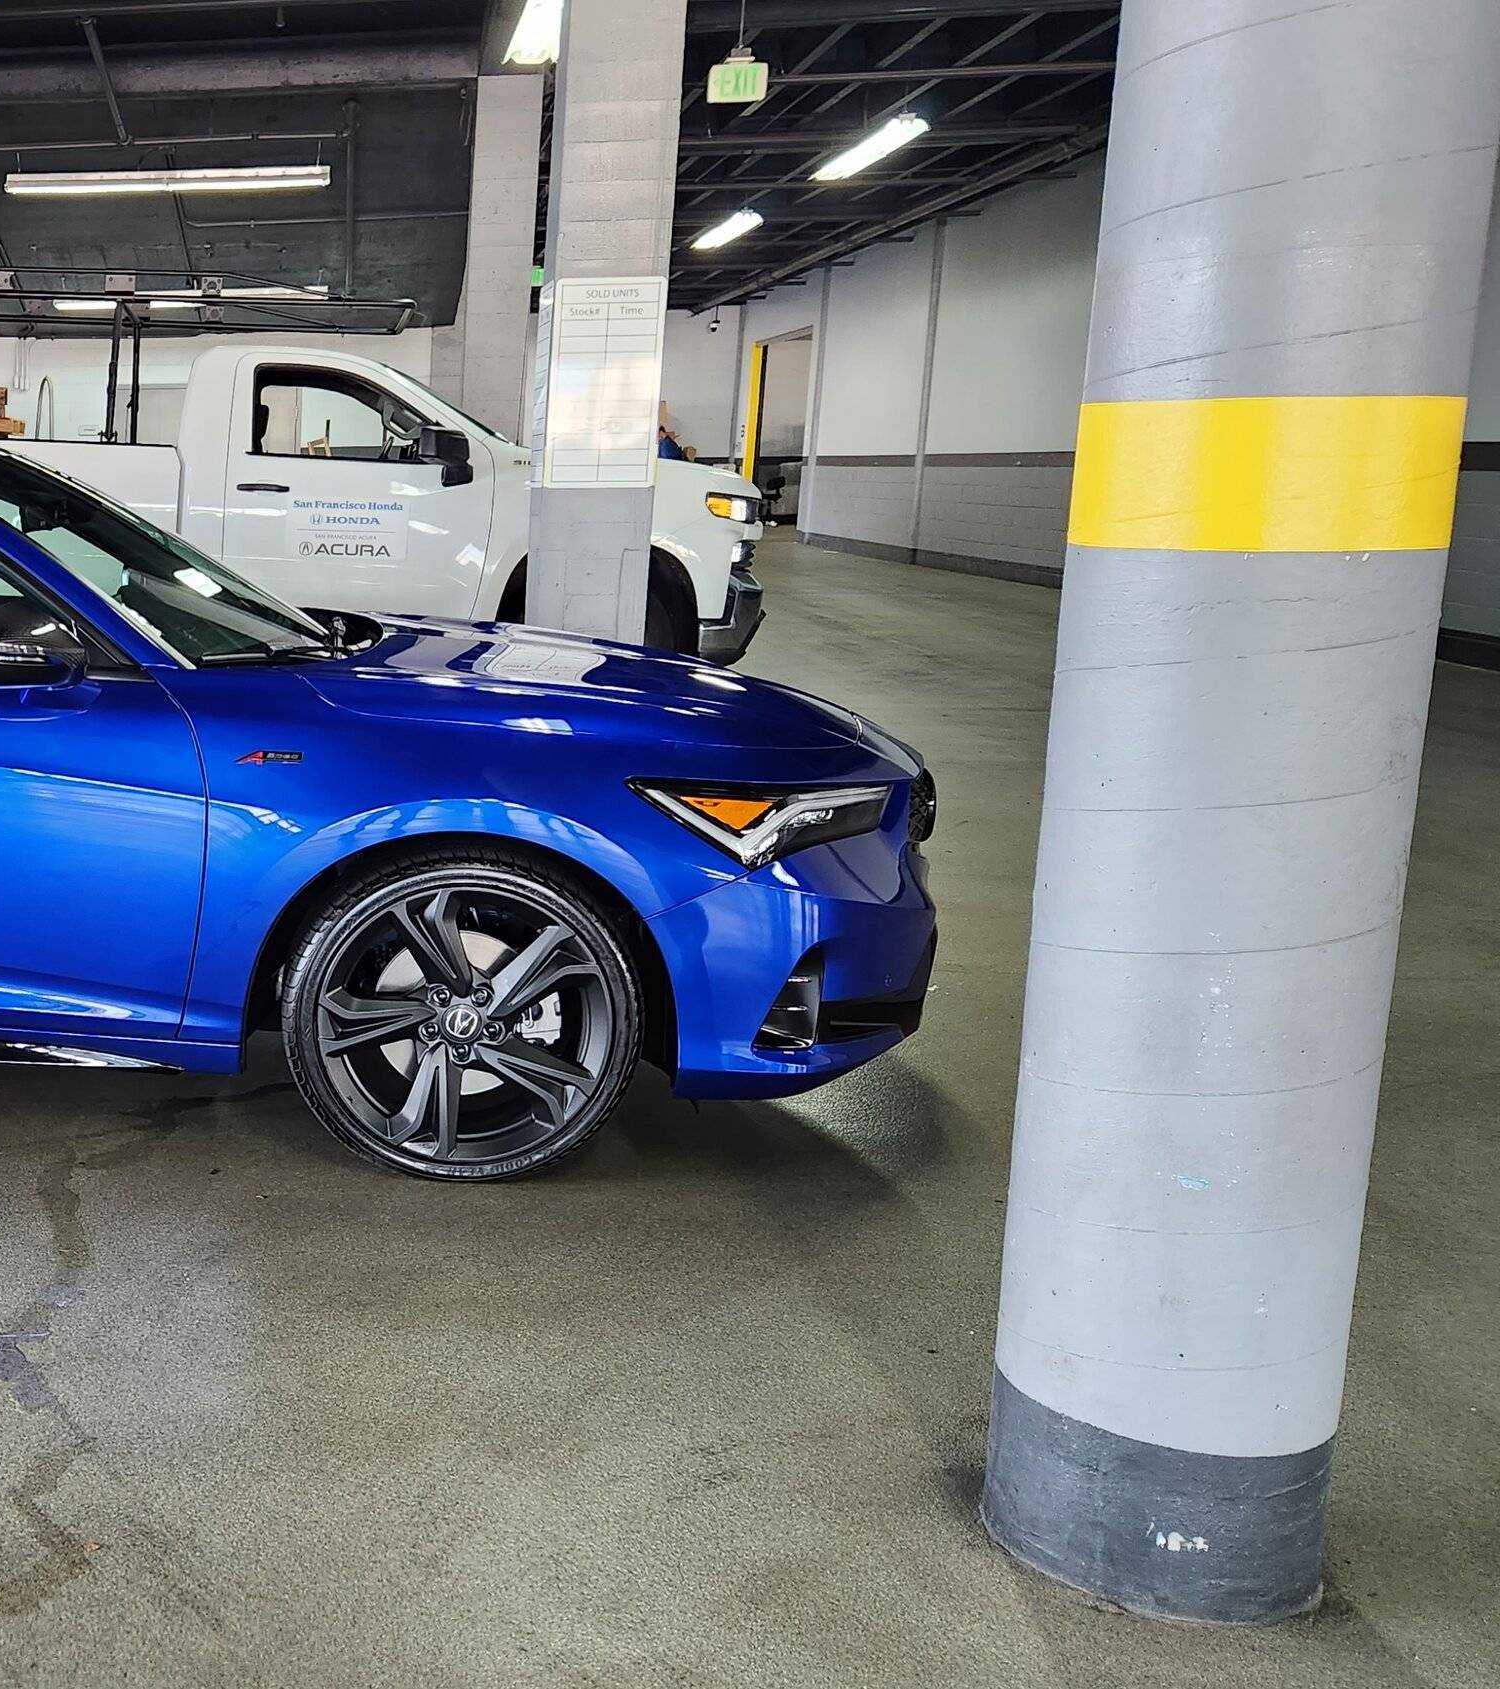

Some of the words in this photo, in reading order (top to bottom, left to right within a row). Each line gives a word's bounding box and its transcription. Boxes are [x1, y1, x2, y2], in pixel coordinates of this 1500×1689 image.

[719, 67, 758, 97] EXIT
[586, 289, 610, 299] SOLD
[613, 288, 640, 298] UNITS
[570, 307, 600, 316] Stock#
[620, 306, 644, 315] Time
[293, 500, 313, 508] San
[314, 500, 366, 510] Francisco
[368, 501, 403, 511] Honda
[326, 516, 381, 525] HONDA
[314, 543, 390, 557] ACURA
